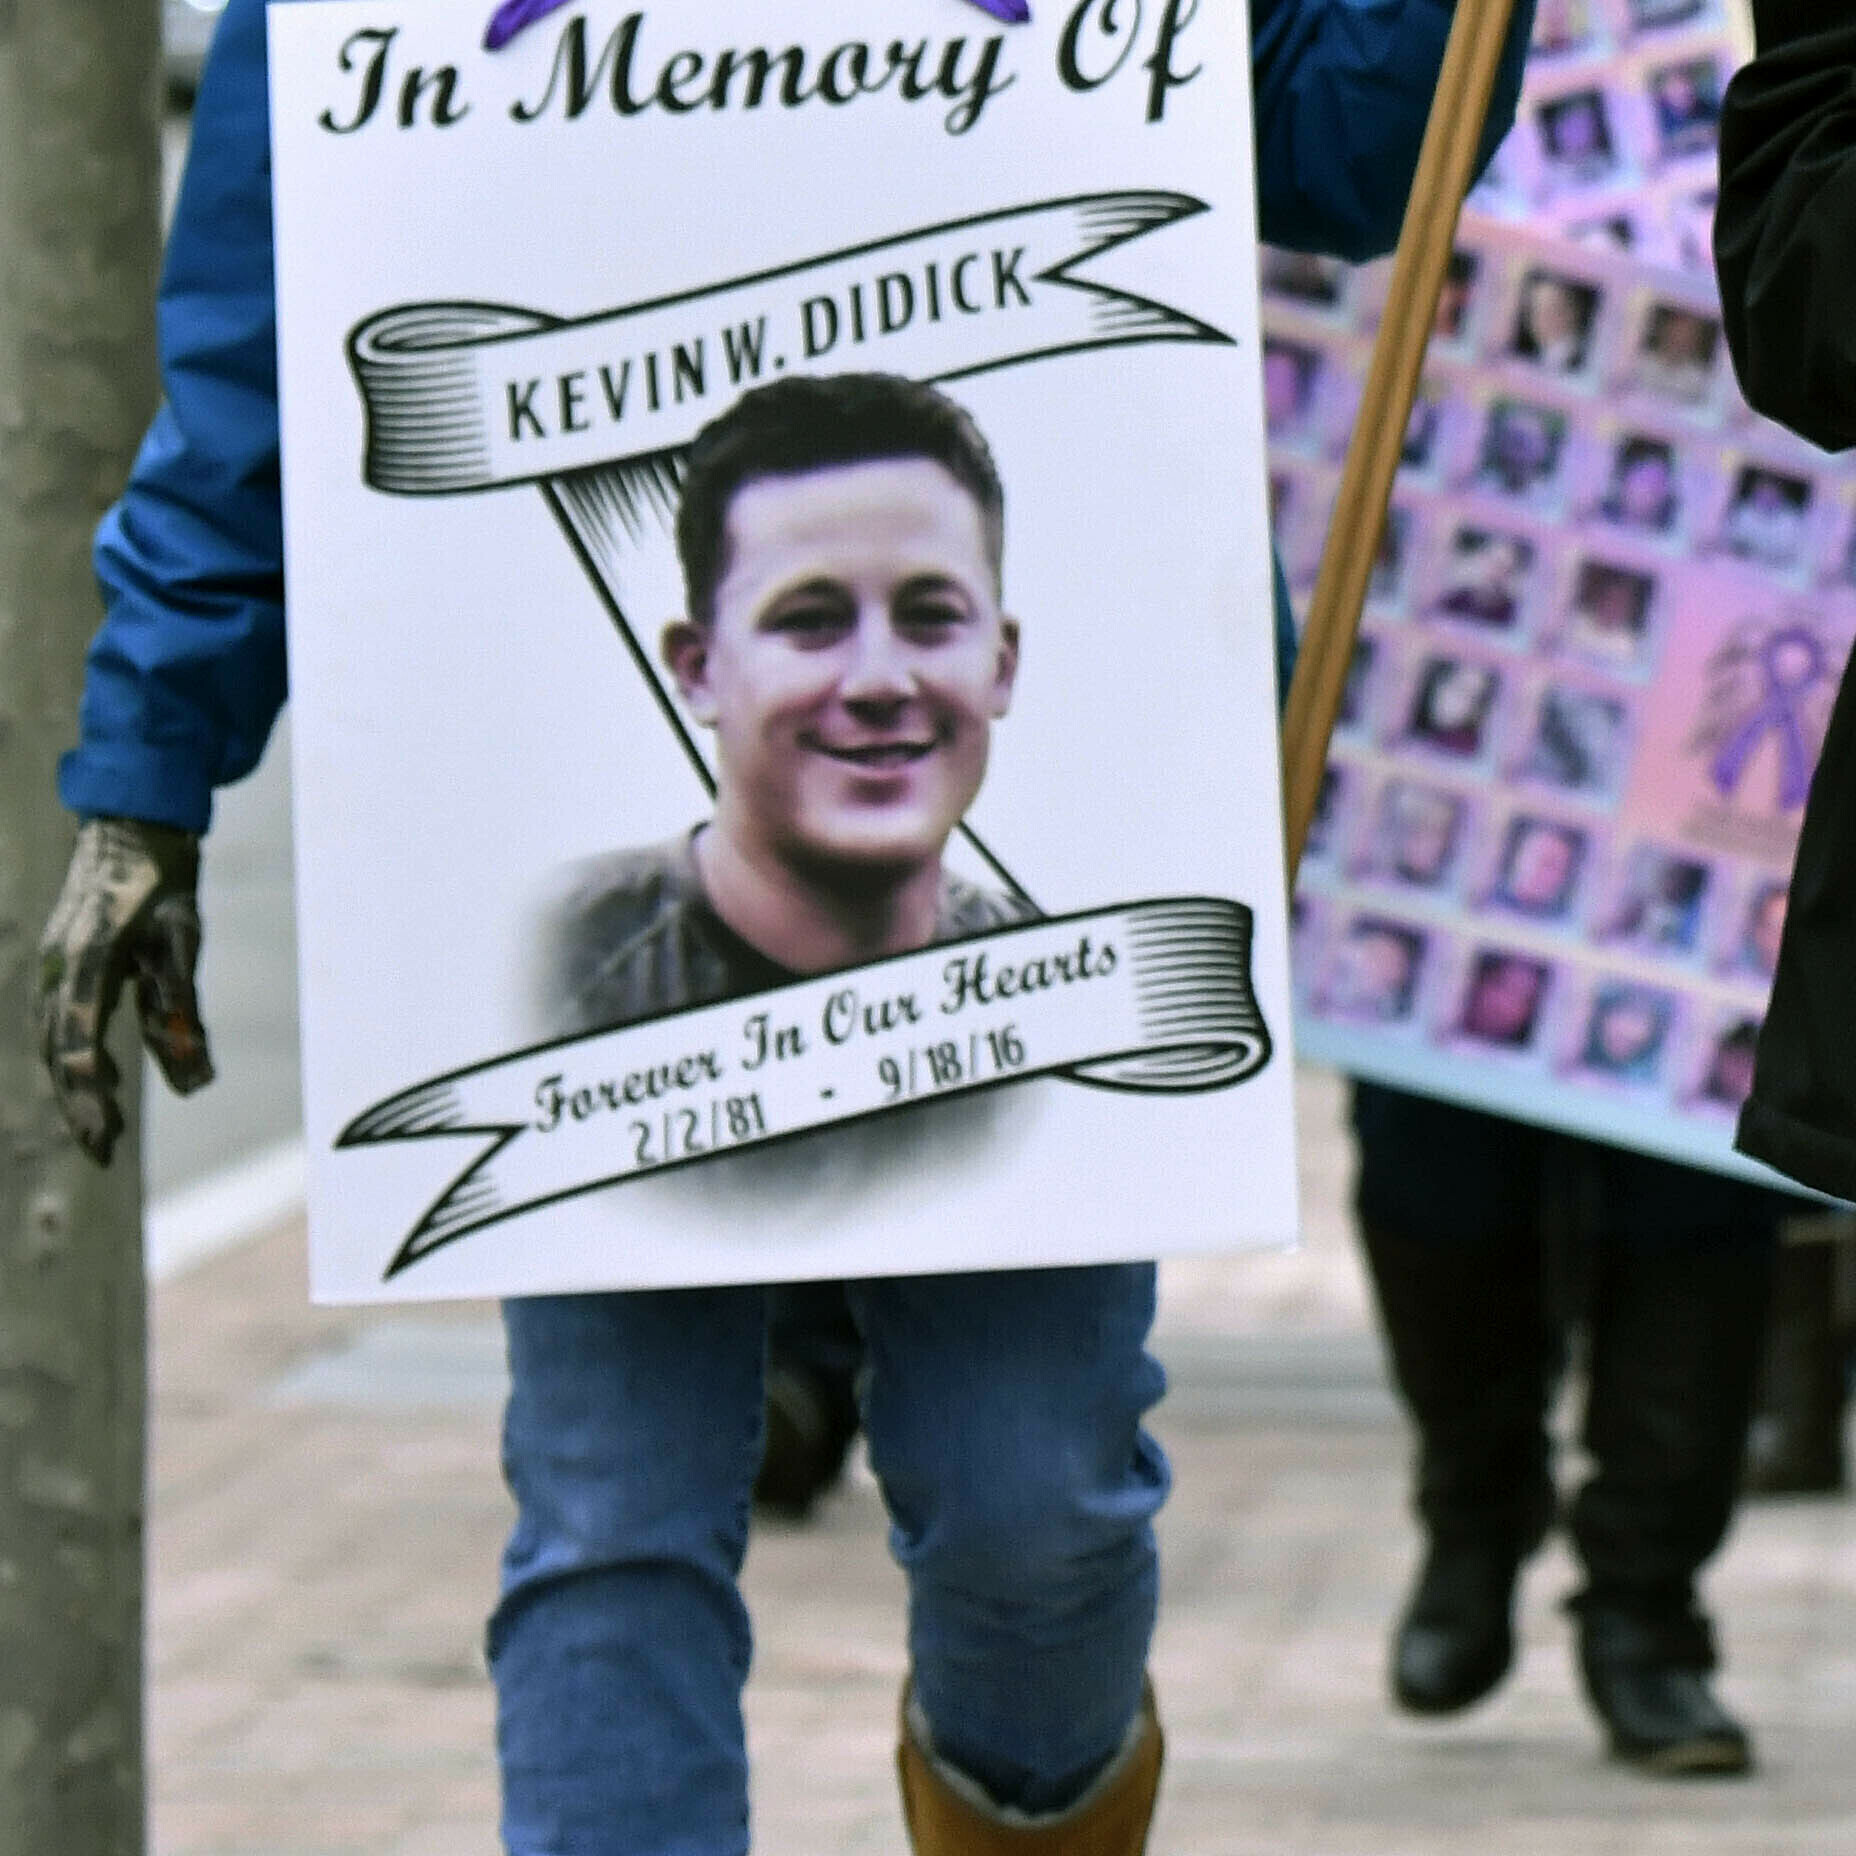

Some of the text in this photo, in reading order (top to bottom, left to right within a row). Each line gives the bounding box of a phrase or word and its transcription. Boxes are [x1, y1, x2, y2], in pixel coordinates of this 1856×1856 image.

[319, 27, 467, 134] In
[510, 12, 1014, 136] Memory
[507, 247, 1031, 441] KEVIN W. DIDICK
[534, 937, 1117, 1135] Forever In Our Hearts
[631, 1091, 766, 1166] 2/2/81
[879, 1027, 1025, 1095] 9/18/16
